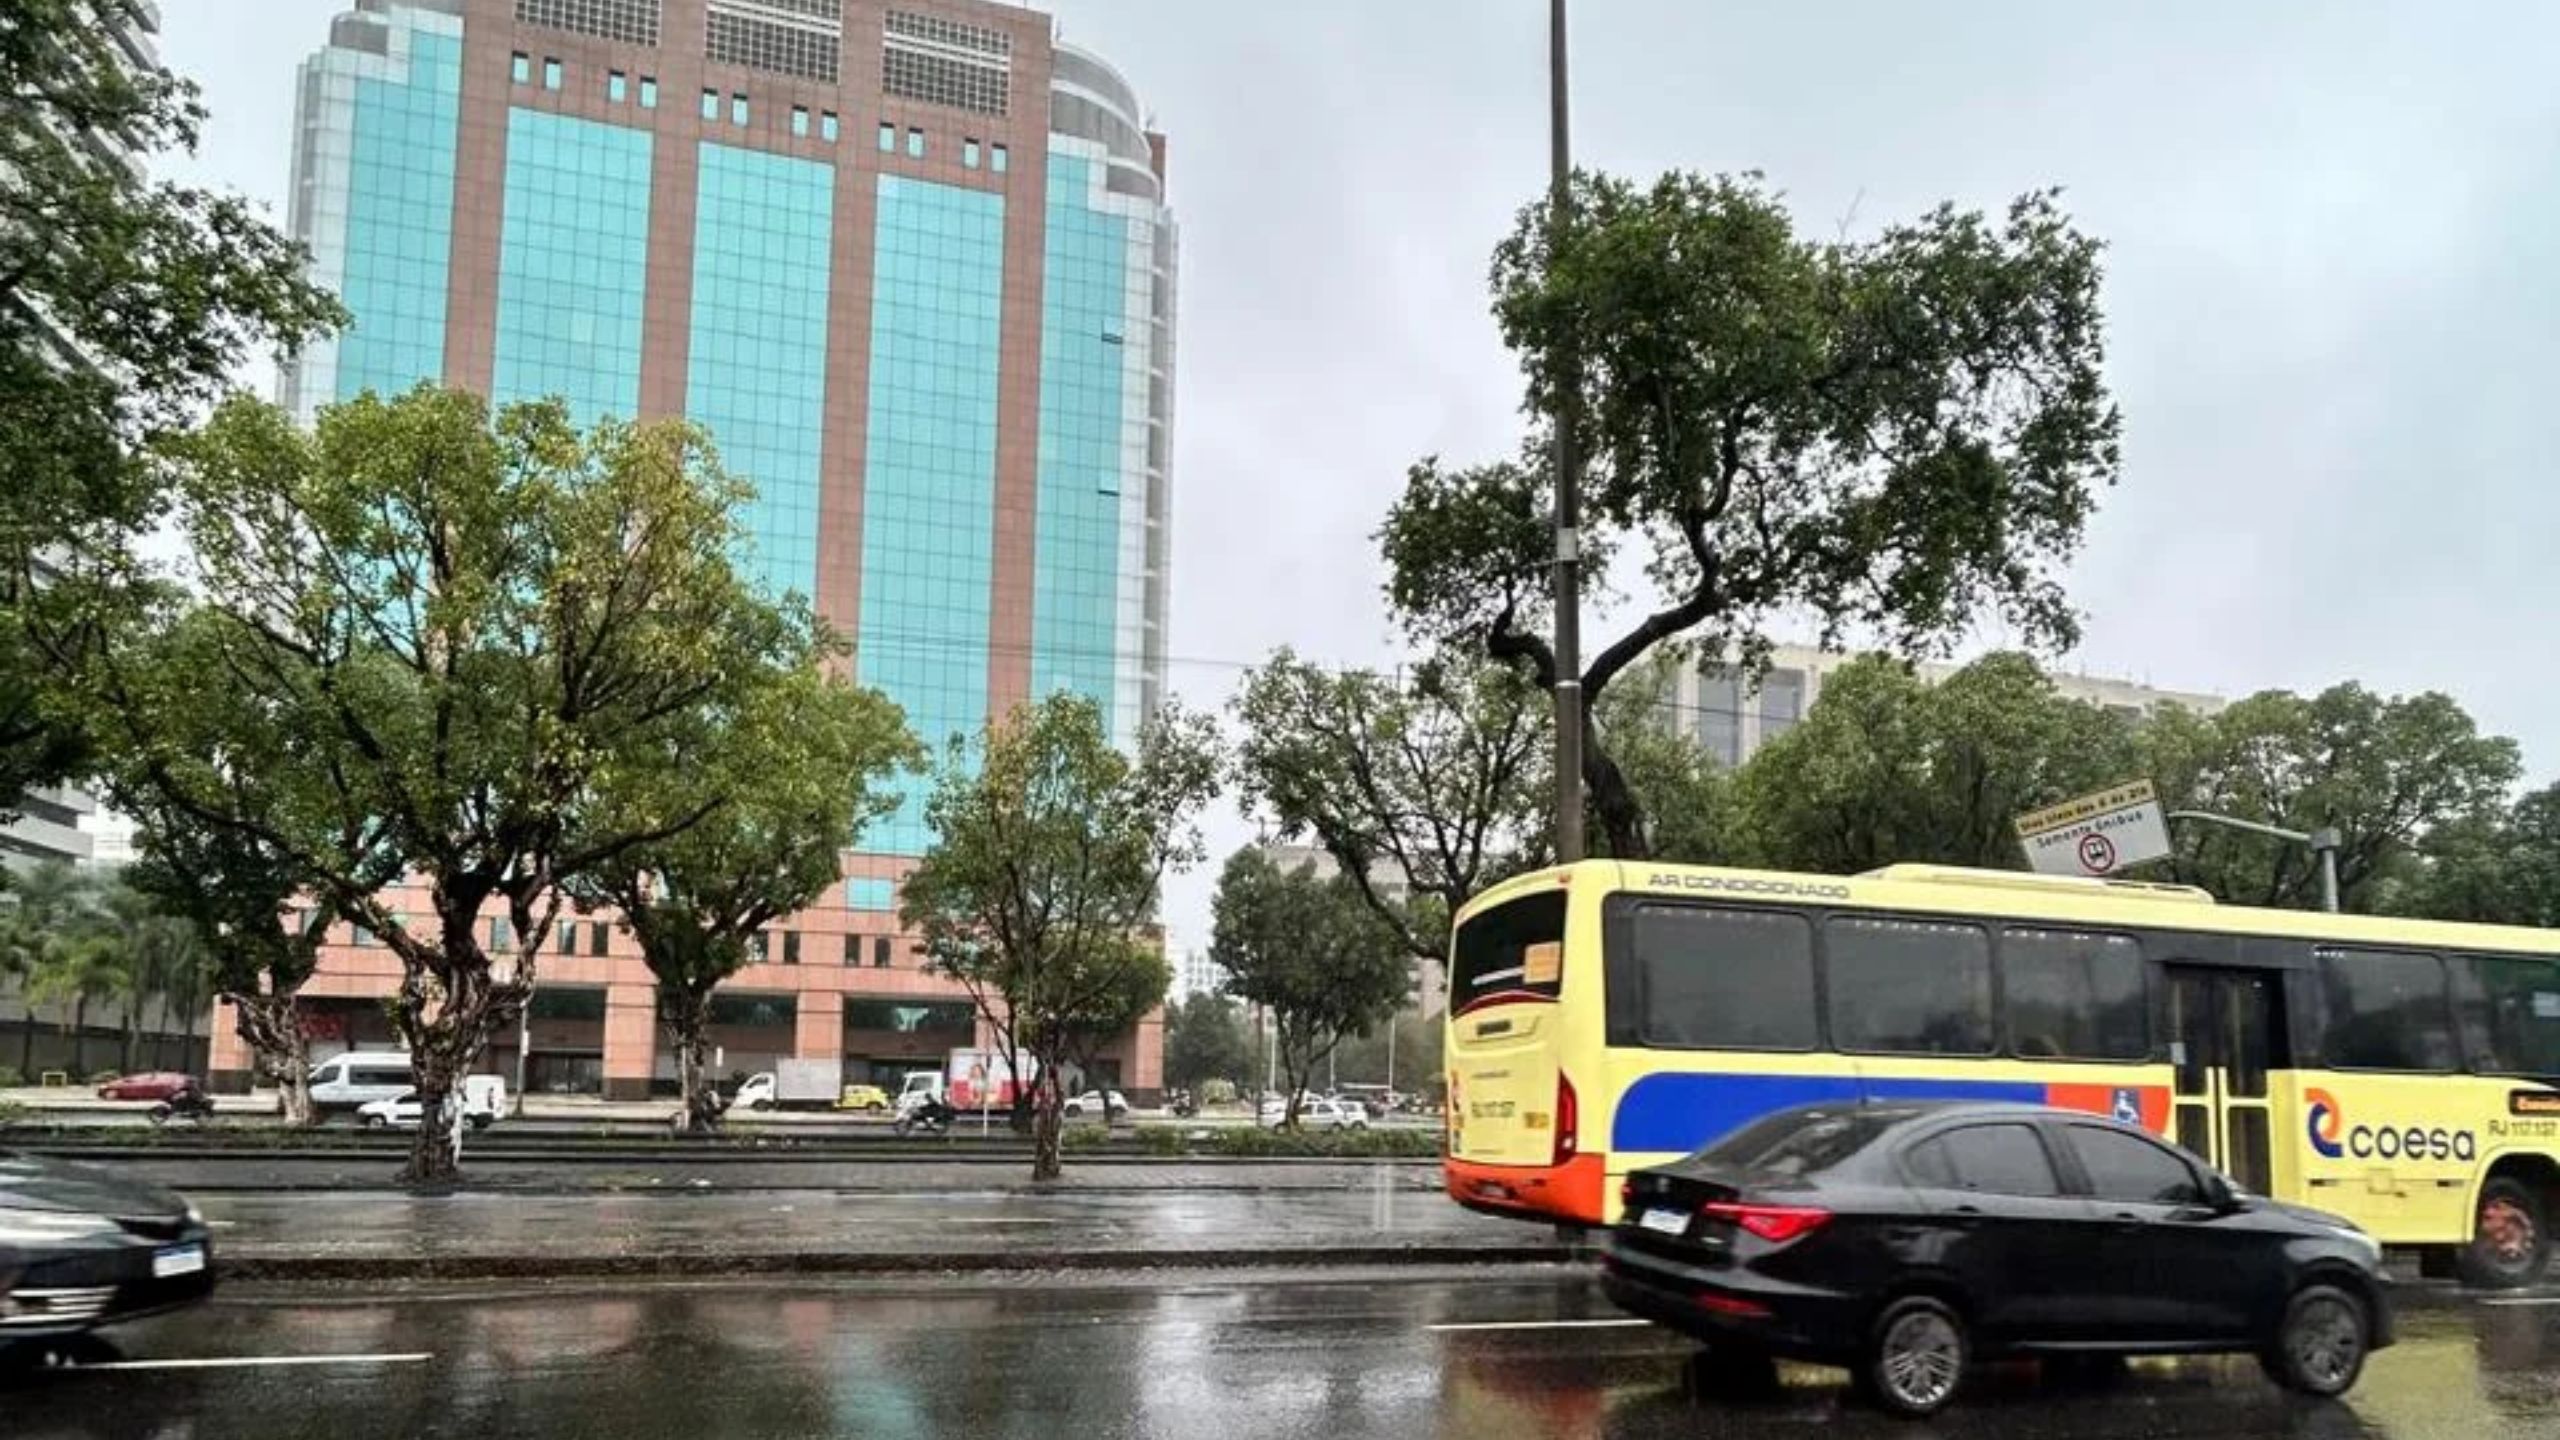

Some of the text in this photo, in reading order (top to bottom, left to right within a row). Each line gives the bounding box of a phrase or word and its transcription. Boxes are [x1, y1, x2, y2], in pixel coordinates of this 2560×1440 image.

[1649, 873, 1850, 899] AR CONDICIONADO
[2488, 1119, 2507, 1137] RJ
[2350, 1125, 2476, 1161] coesa
